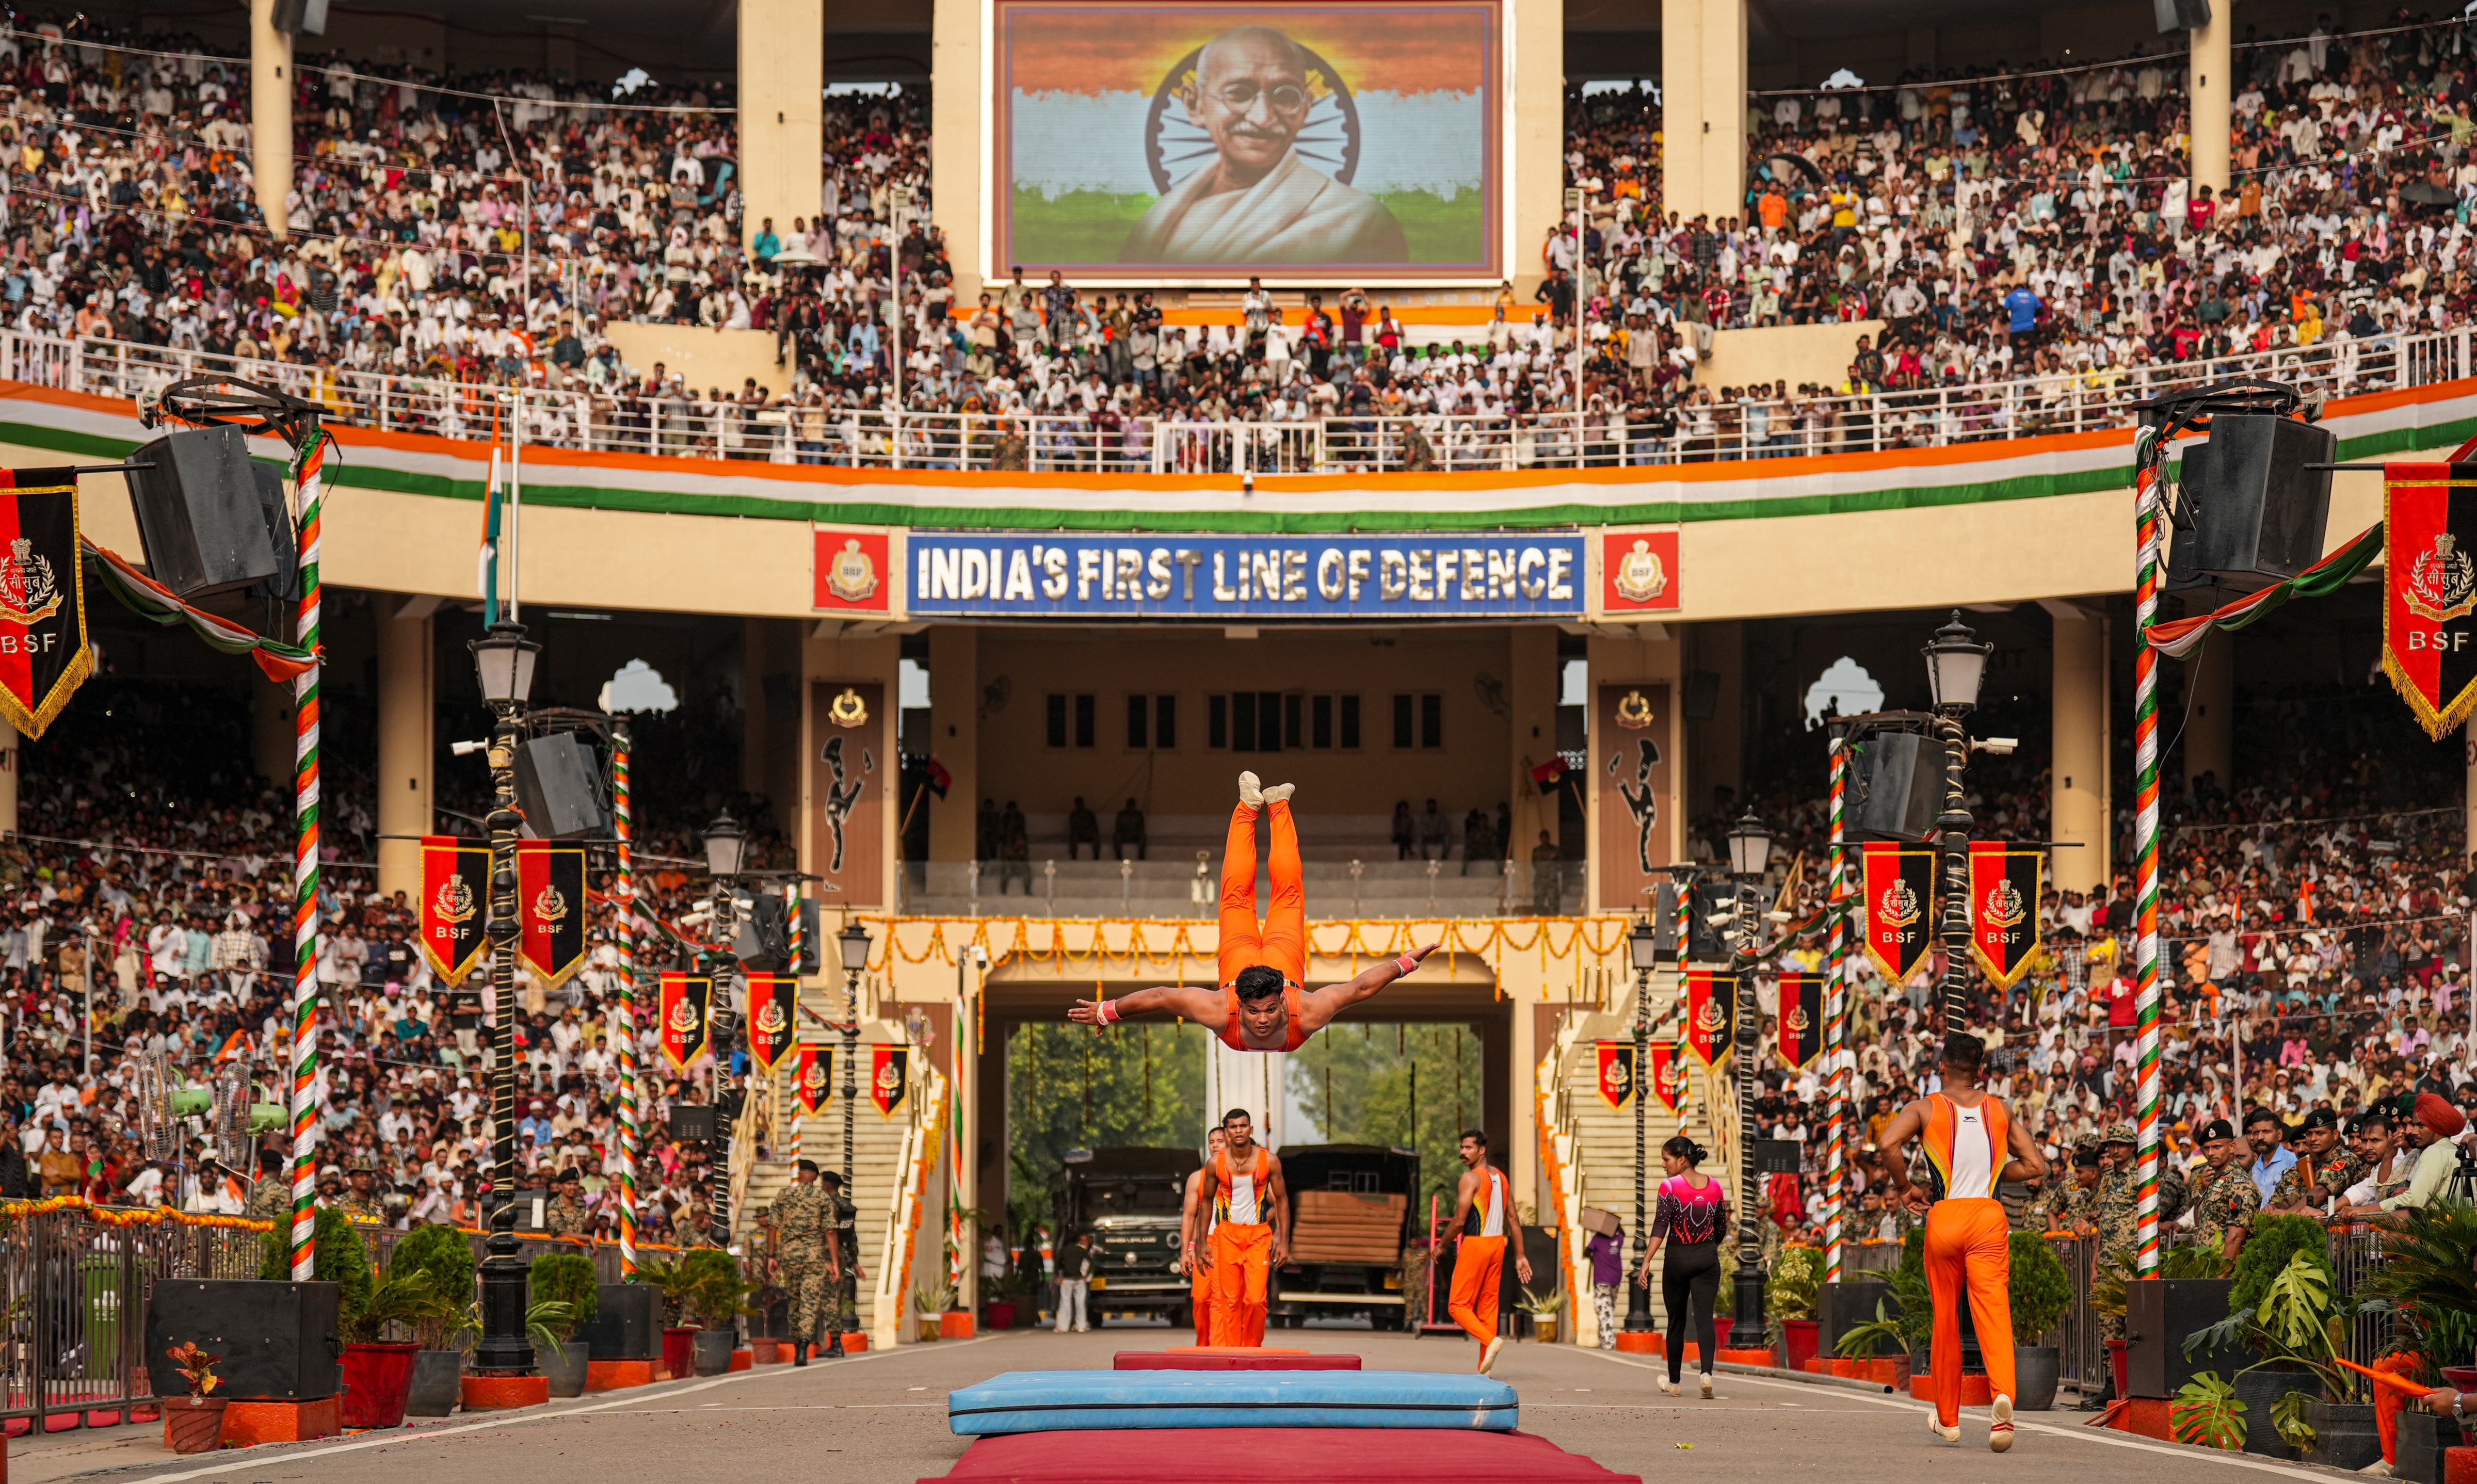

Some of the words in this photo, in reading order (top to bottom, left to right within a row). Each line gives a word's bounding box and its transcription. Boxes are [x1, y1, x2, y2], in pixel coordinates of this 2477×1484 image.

[918, 546, 1068, 602] INDIA'S
[1077, 547, 1202, 602] FIRST
[1213, 547, 1308, 602] LINE
[1317, 547, 1371, 601] OF
[1379, 547, 1574, 602] DEFENCE
[1, 633, 57, 654] BSF
[2409, 631, 2469, 652] BSF
[436, 926, 471, 940] BSF
[538, 925, 563, 934] BSF
[1883, 931, 1916, 944] BSF
[1987, 931, 2021, 944] BSF
[671, 1034, 696, 1044] BSF
[758, 1035, 782, 1045] BSF
[1699, 1034, 1724, 1044] BSF
[806, 1089, 825, 1098] BSF
[878, 1089, 898, 1098] BSF
[1607, 1085, 1627, 1093] BSF
[2353, 1225, 2364, 1235] BSF
